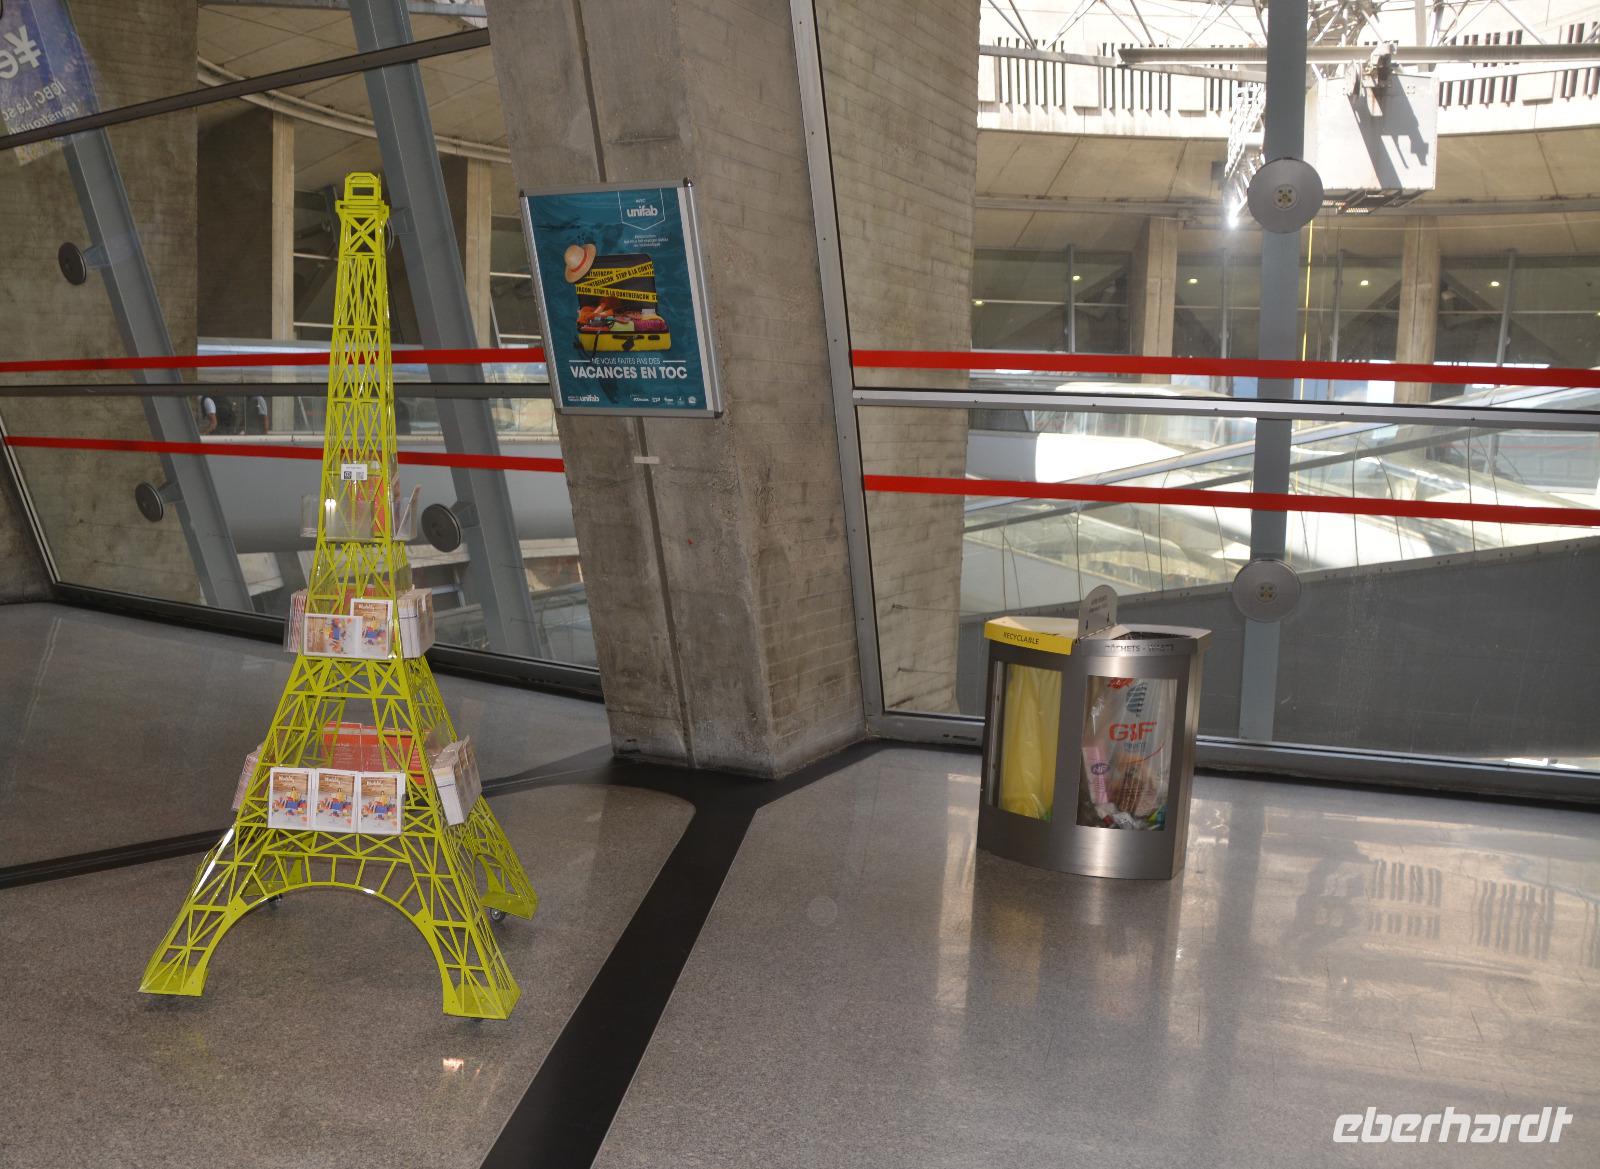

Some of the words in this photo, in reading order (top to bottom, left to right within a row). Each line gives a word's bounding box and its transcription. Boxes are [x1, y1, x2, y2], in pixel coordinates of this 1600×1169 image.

[627, 204, 659, 217] unifab
[601, 357, 617, 365] VOUS
[617, 357, 636, 365] FAITES
[570, 365, 637, 380] VACANCES
[640, 366, 657, 379] EN
[658, 366, 688, 380] TOC
[1003, 631, 1040, 645] RECYCLABLE
